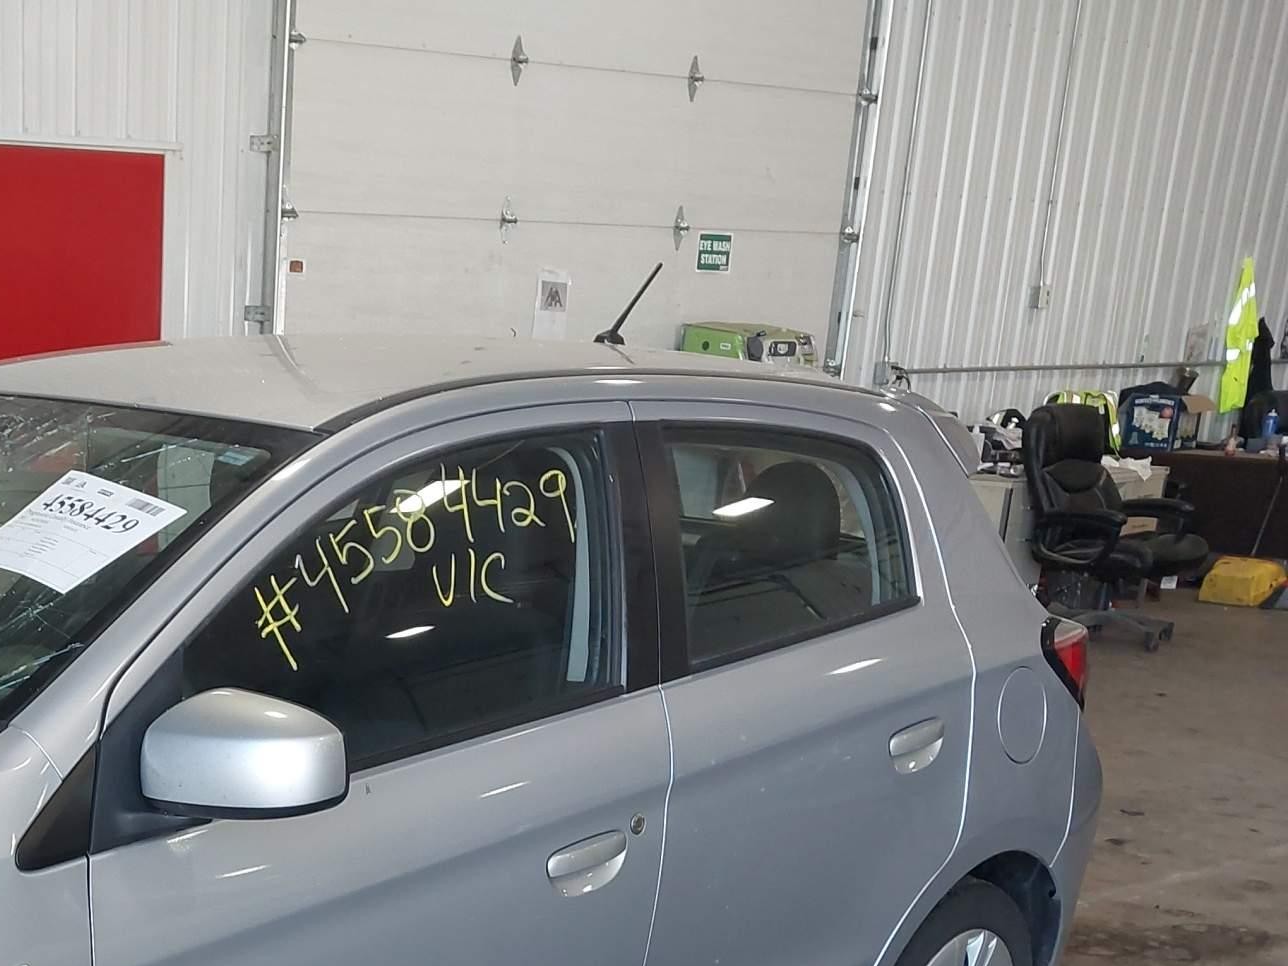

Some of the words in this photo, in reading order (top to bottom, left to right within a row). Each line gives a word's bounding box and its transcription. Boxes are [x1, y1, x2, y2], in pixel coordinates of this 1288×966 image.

[699, 239, 712, 251] EYE
[700, 253, 727, 265] STATION
[43, 494, 140, 533] 45584429
[254, 463, 576, 671] #45584429
